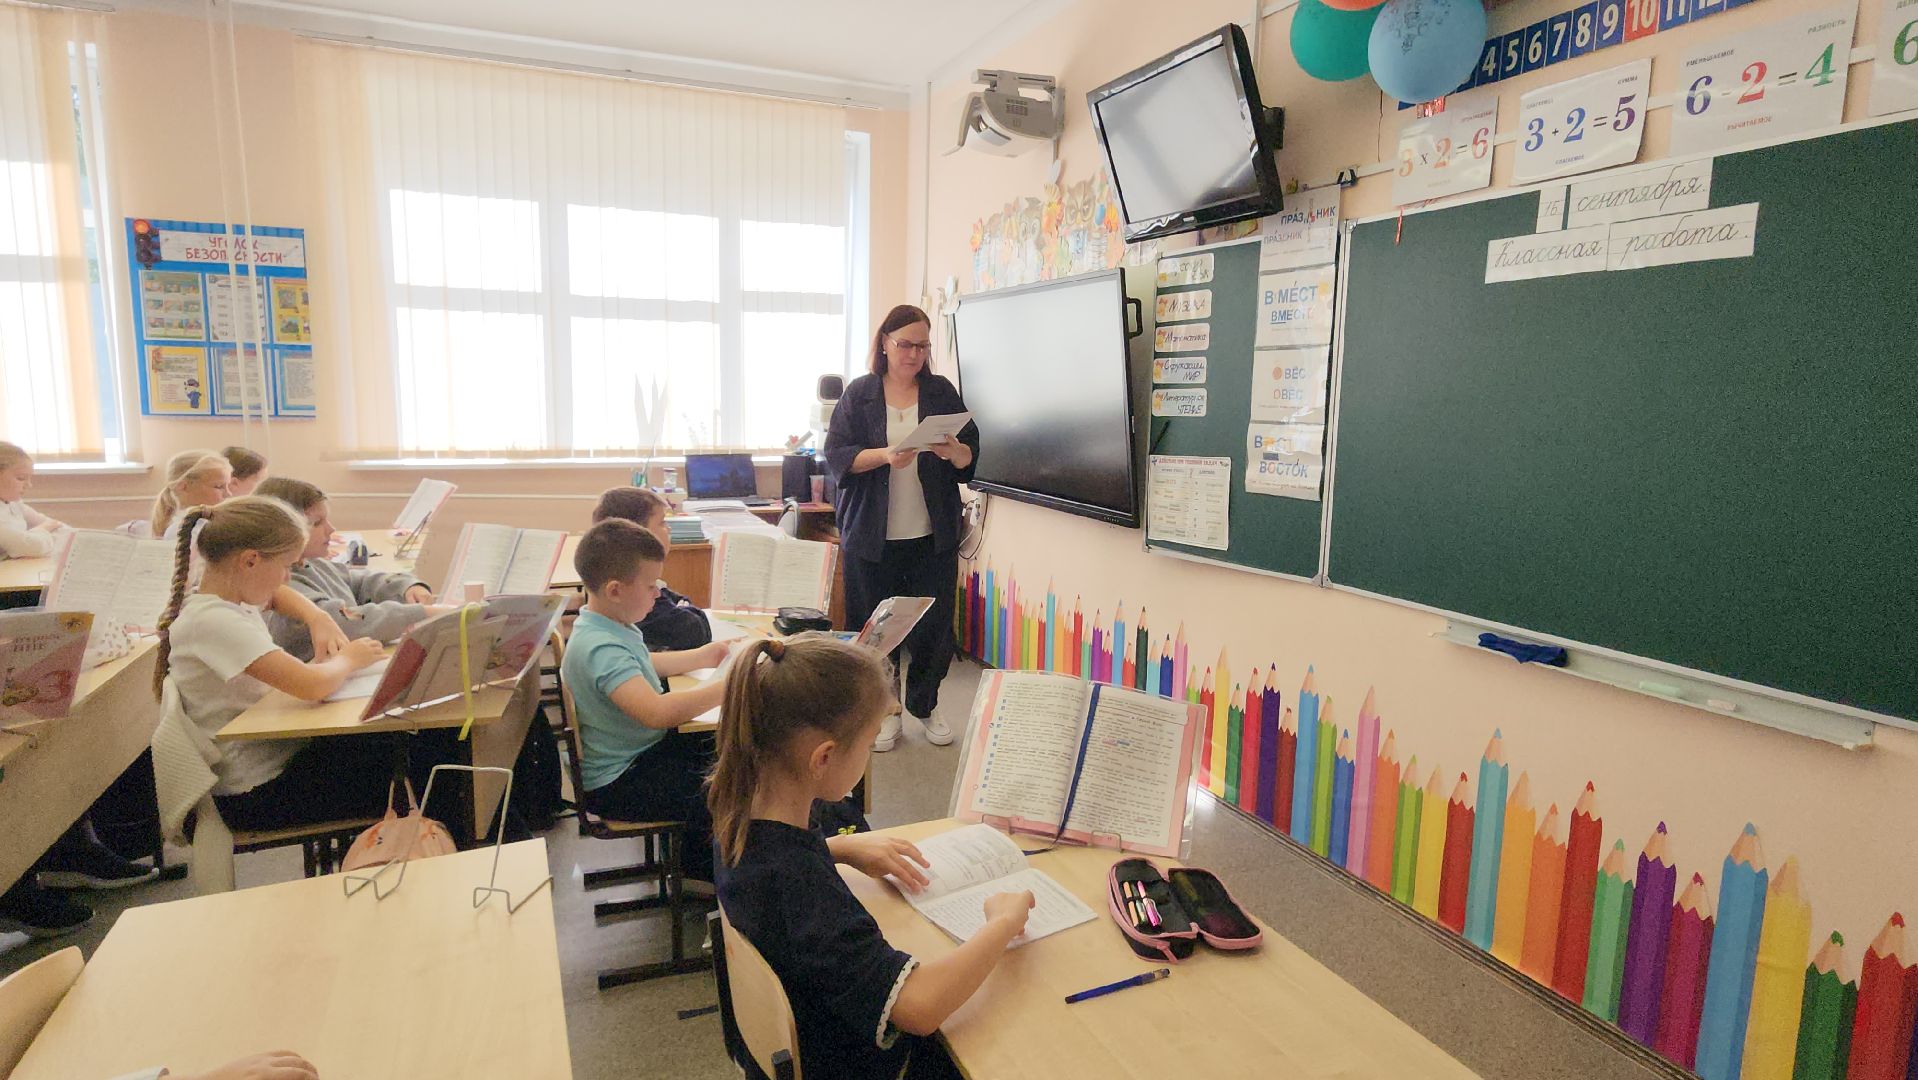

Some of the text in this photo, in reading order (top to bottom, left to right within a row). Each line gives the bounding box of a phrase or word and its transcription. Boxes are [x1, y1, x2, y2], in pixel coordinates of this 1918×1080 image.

[1482, 47, 1496, 76] 4
[1505, 39, 1519, 71] 5
[1528, 31, 1542, 63] 6
[1552, 22, 1567, 56] 7
[1575, 12, 1591, 48] 8
[1602, 3, 1619, 40] 9
[1630, 0, 1656, 32] 10
[1685, 49, 1735, 67] УМЕНЬШАЕМОЕ
[1686, 75, 1713, 116] 6
[1737, 61, 1767, 104] 2
[1804, 42, 1836, 87] 4
[1524, 117, 1544, 152] 3
[1563, 107, 1586, 143] 2
[1613, 93, 1637, 131] 5
[1399, 148, 1414, 177] 3
[1434, 137, 1452, 169] 2
[1472, 127, 1490, 159] 6
[1494, 239, 1601, 268] Классная
